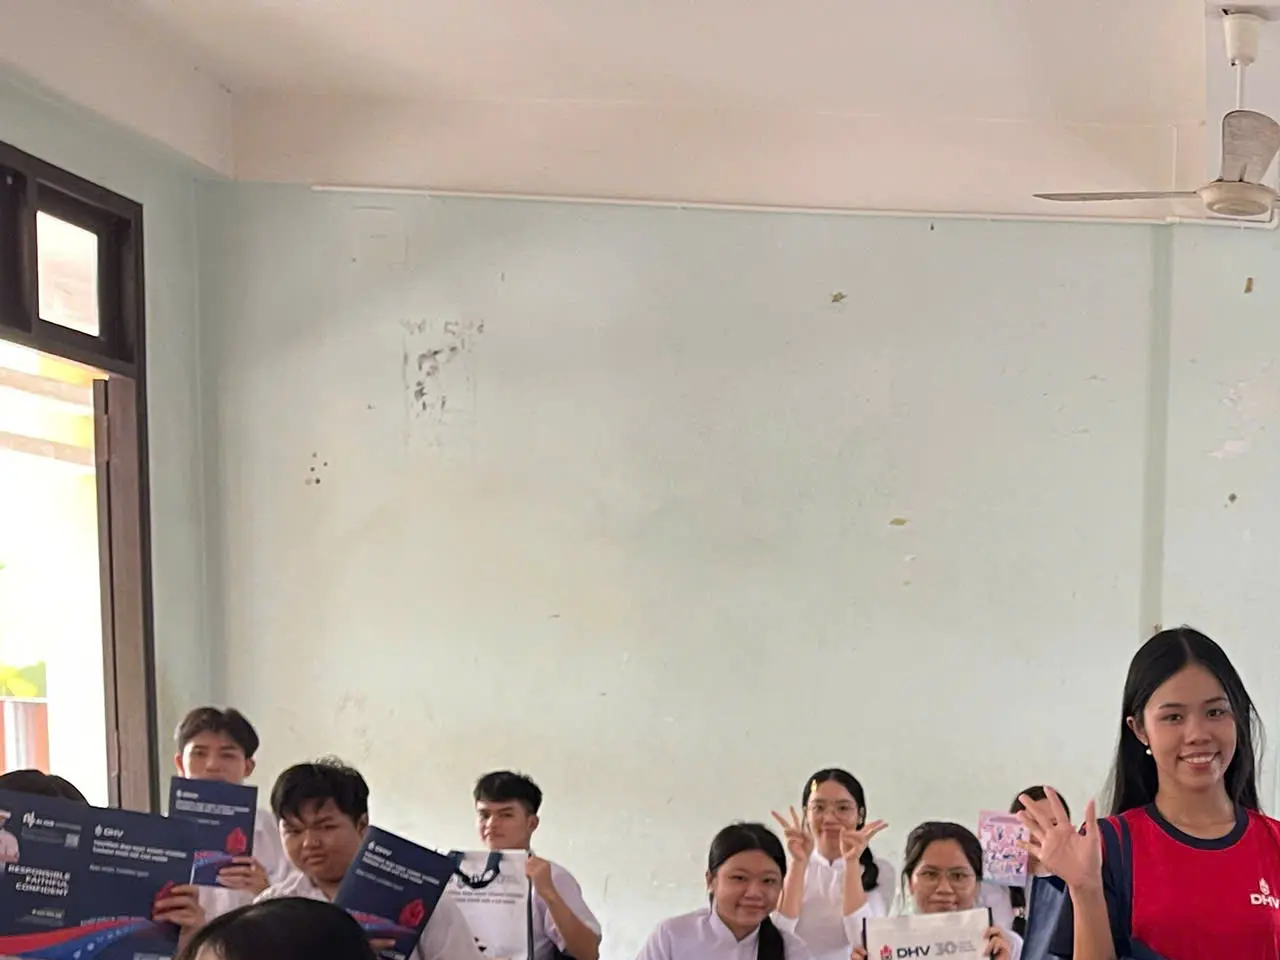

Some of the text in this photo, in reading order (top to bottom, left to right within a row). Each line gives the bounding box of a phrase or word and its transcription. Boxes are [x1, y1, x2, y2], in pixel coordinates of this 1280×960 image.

[8, 864, 71, 881] RESPONSIBLE
[15, 881, 69, 897] CONFIDENT
[25, 874, 68, 889] FAITHFUL
[1250, 893, 1280, 909] DHV
[897, 945, 930, 959] DHV
